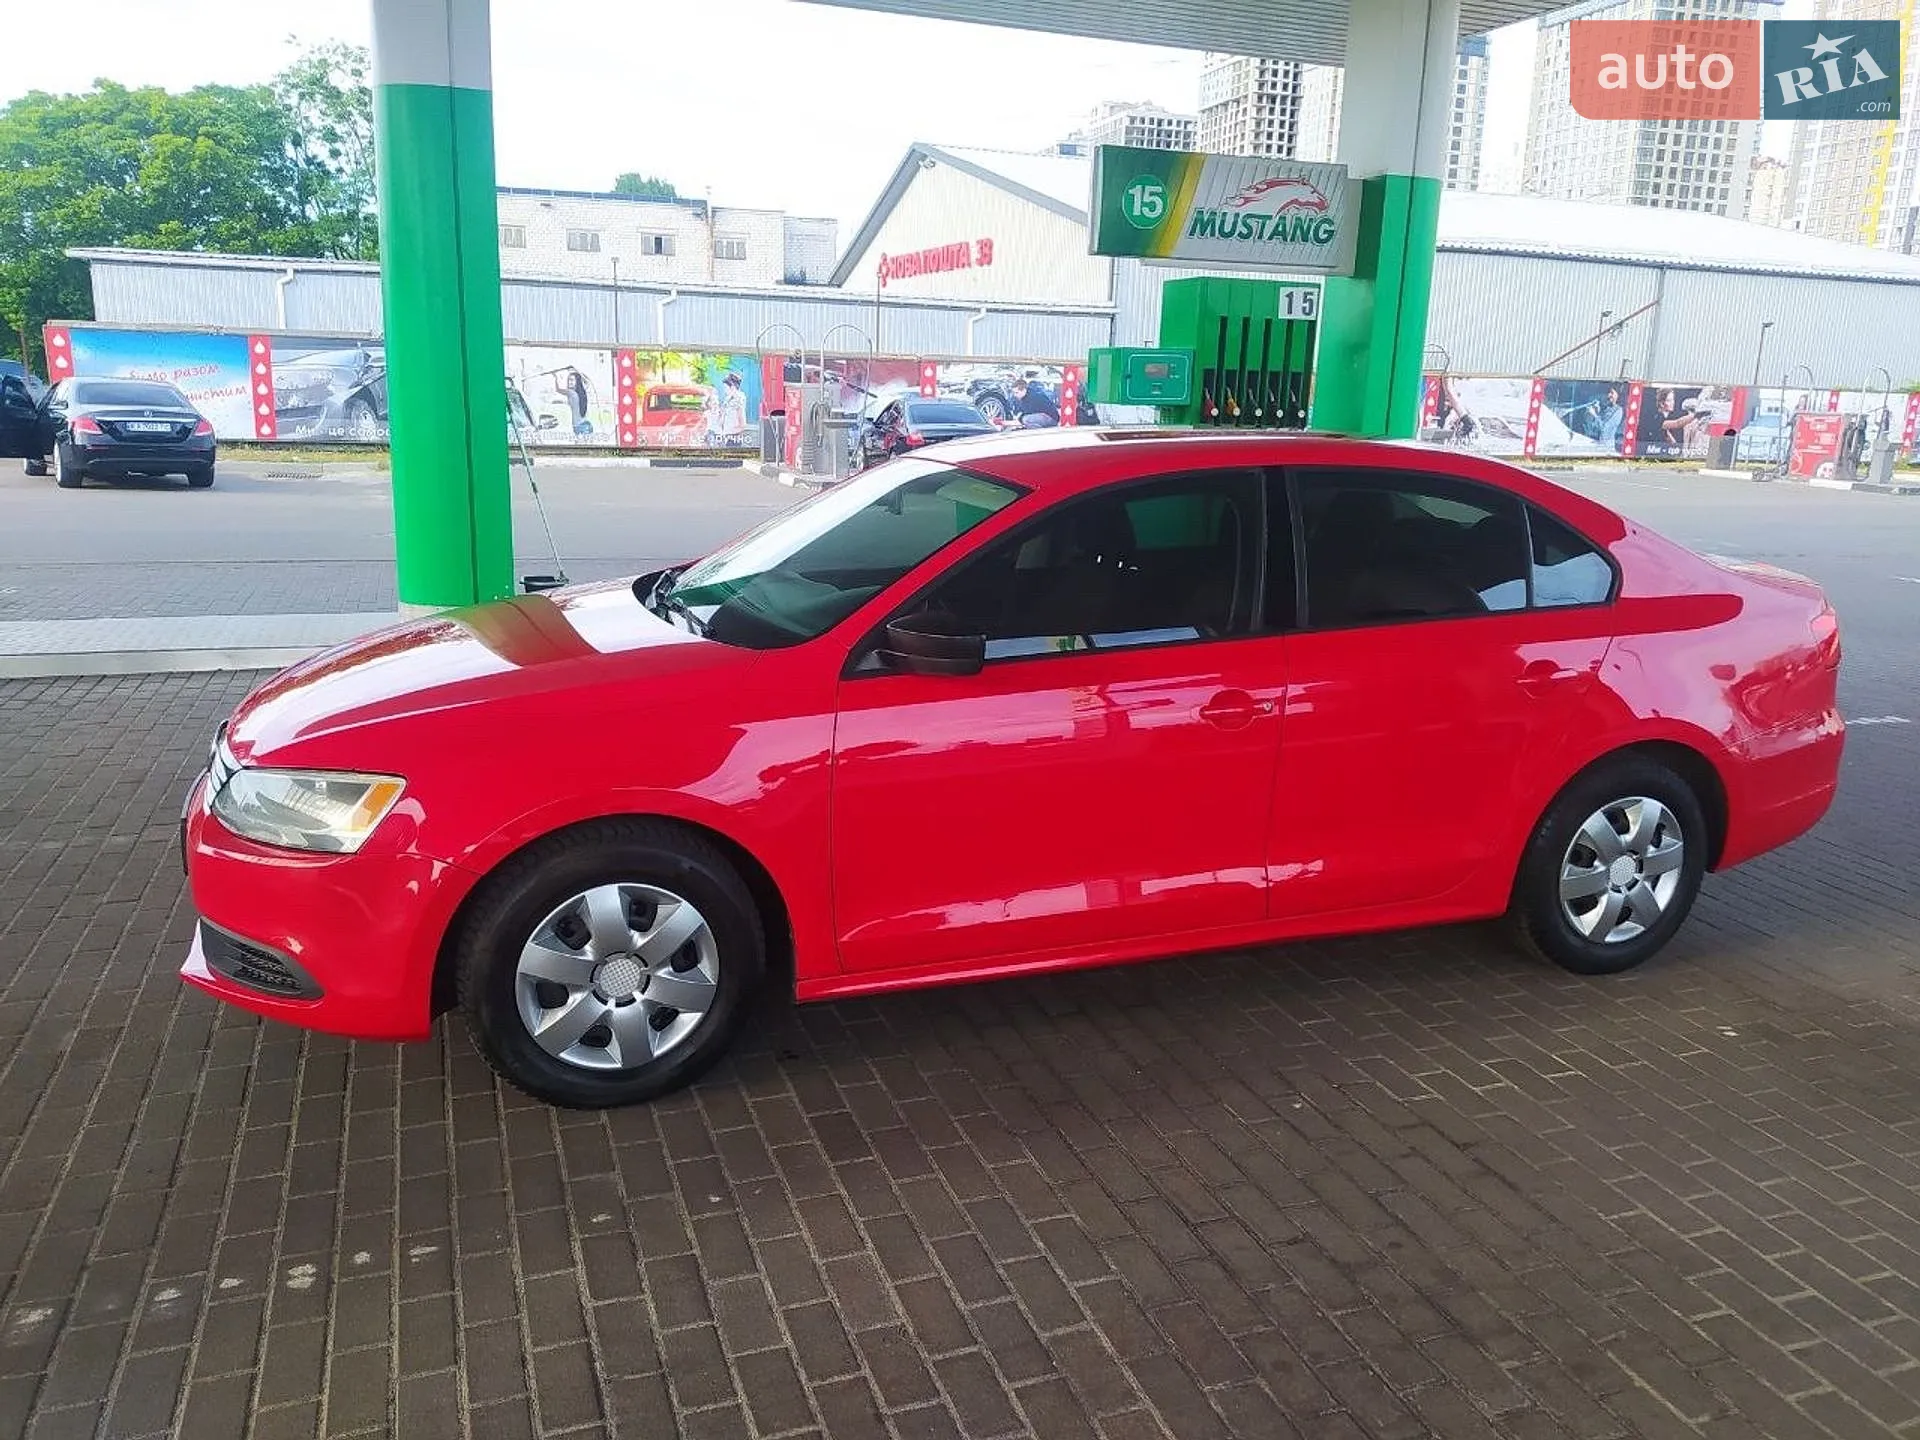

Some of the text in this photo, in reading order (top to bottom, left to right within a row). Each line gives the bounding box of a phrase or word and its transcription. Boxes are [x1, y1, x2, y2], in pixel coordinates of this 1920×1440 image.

[1128, 184, 1164, 219] 15
[1188, 209, 1336, 245] MUSTANG
[1285, 290, 1315, 317] 15
